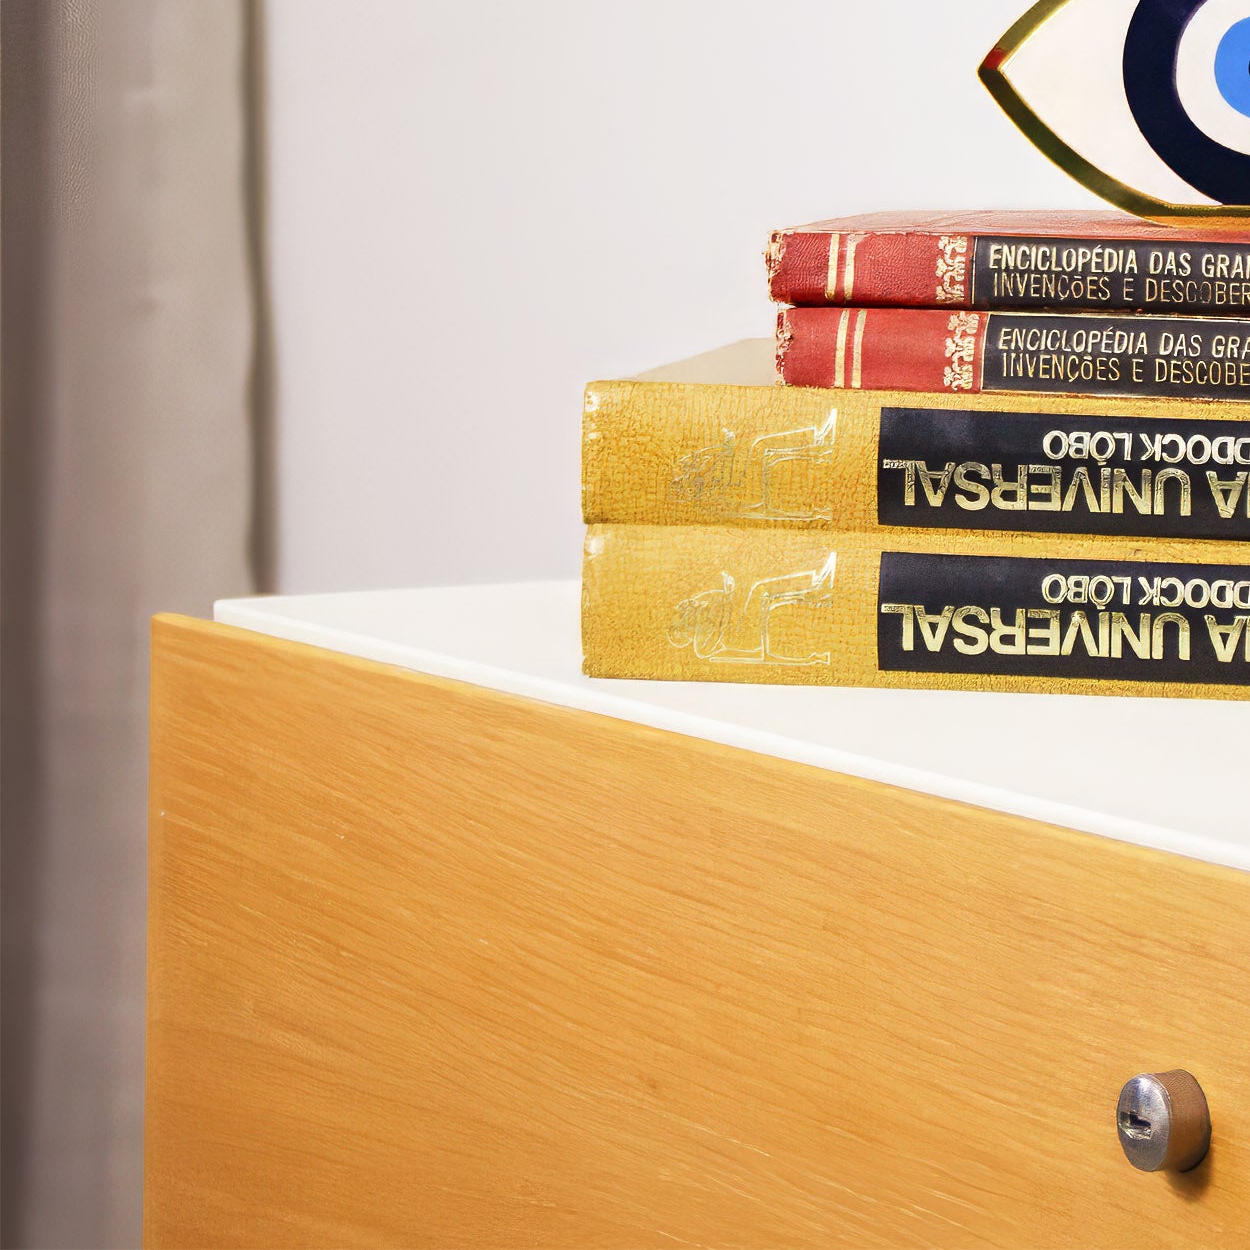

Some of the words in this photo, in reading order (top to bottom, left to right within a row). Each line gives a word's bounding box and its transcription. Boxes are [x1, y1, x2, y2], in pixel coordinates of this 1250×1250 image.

[988, 244, 1138, 272] ENCICLOPÉDIA
[1150, 251, 1191, 277] DAS
[993, 274, 1111, 301] INVENÇÕES
[1123, 278, 1135, 301] E
[999, 327, 1149, 356] ENCICLOPÉDIA
[1159, 333, 1202, 357] DAS
[1002, 353, 1120, 382] INVENÇÕES
[1132, 359, 1144, 382] E
[882, 459, 1192, 517] UNIVERSAL
[880, 604, 1191, 661] UNIVERSAL
